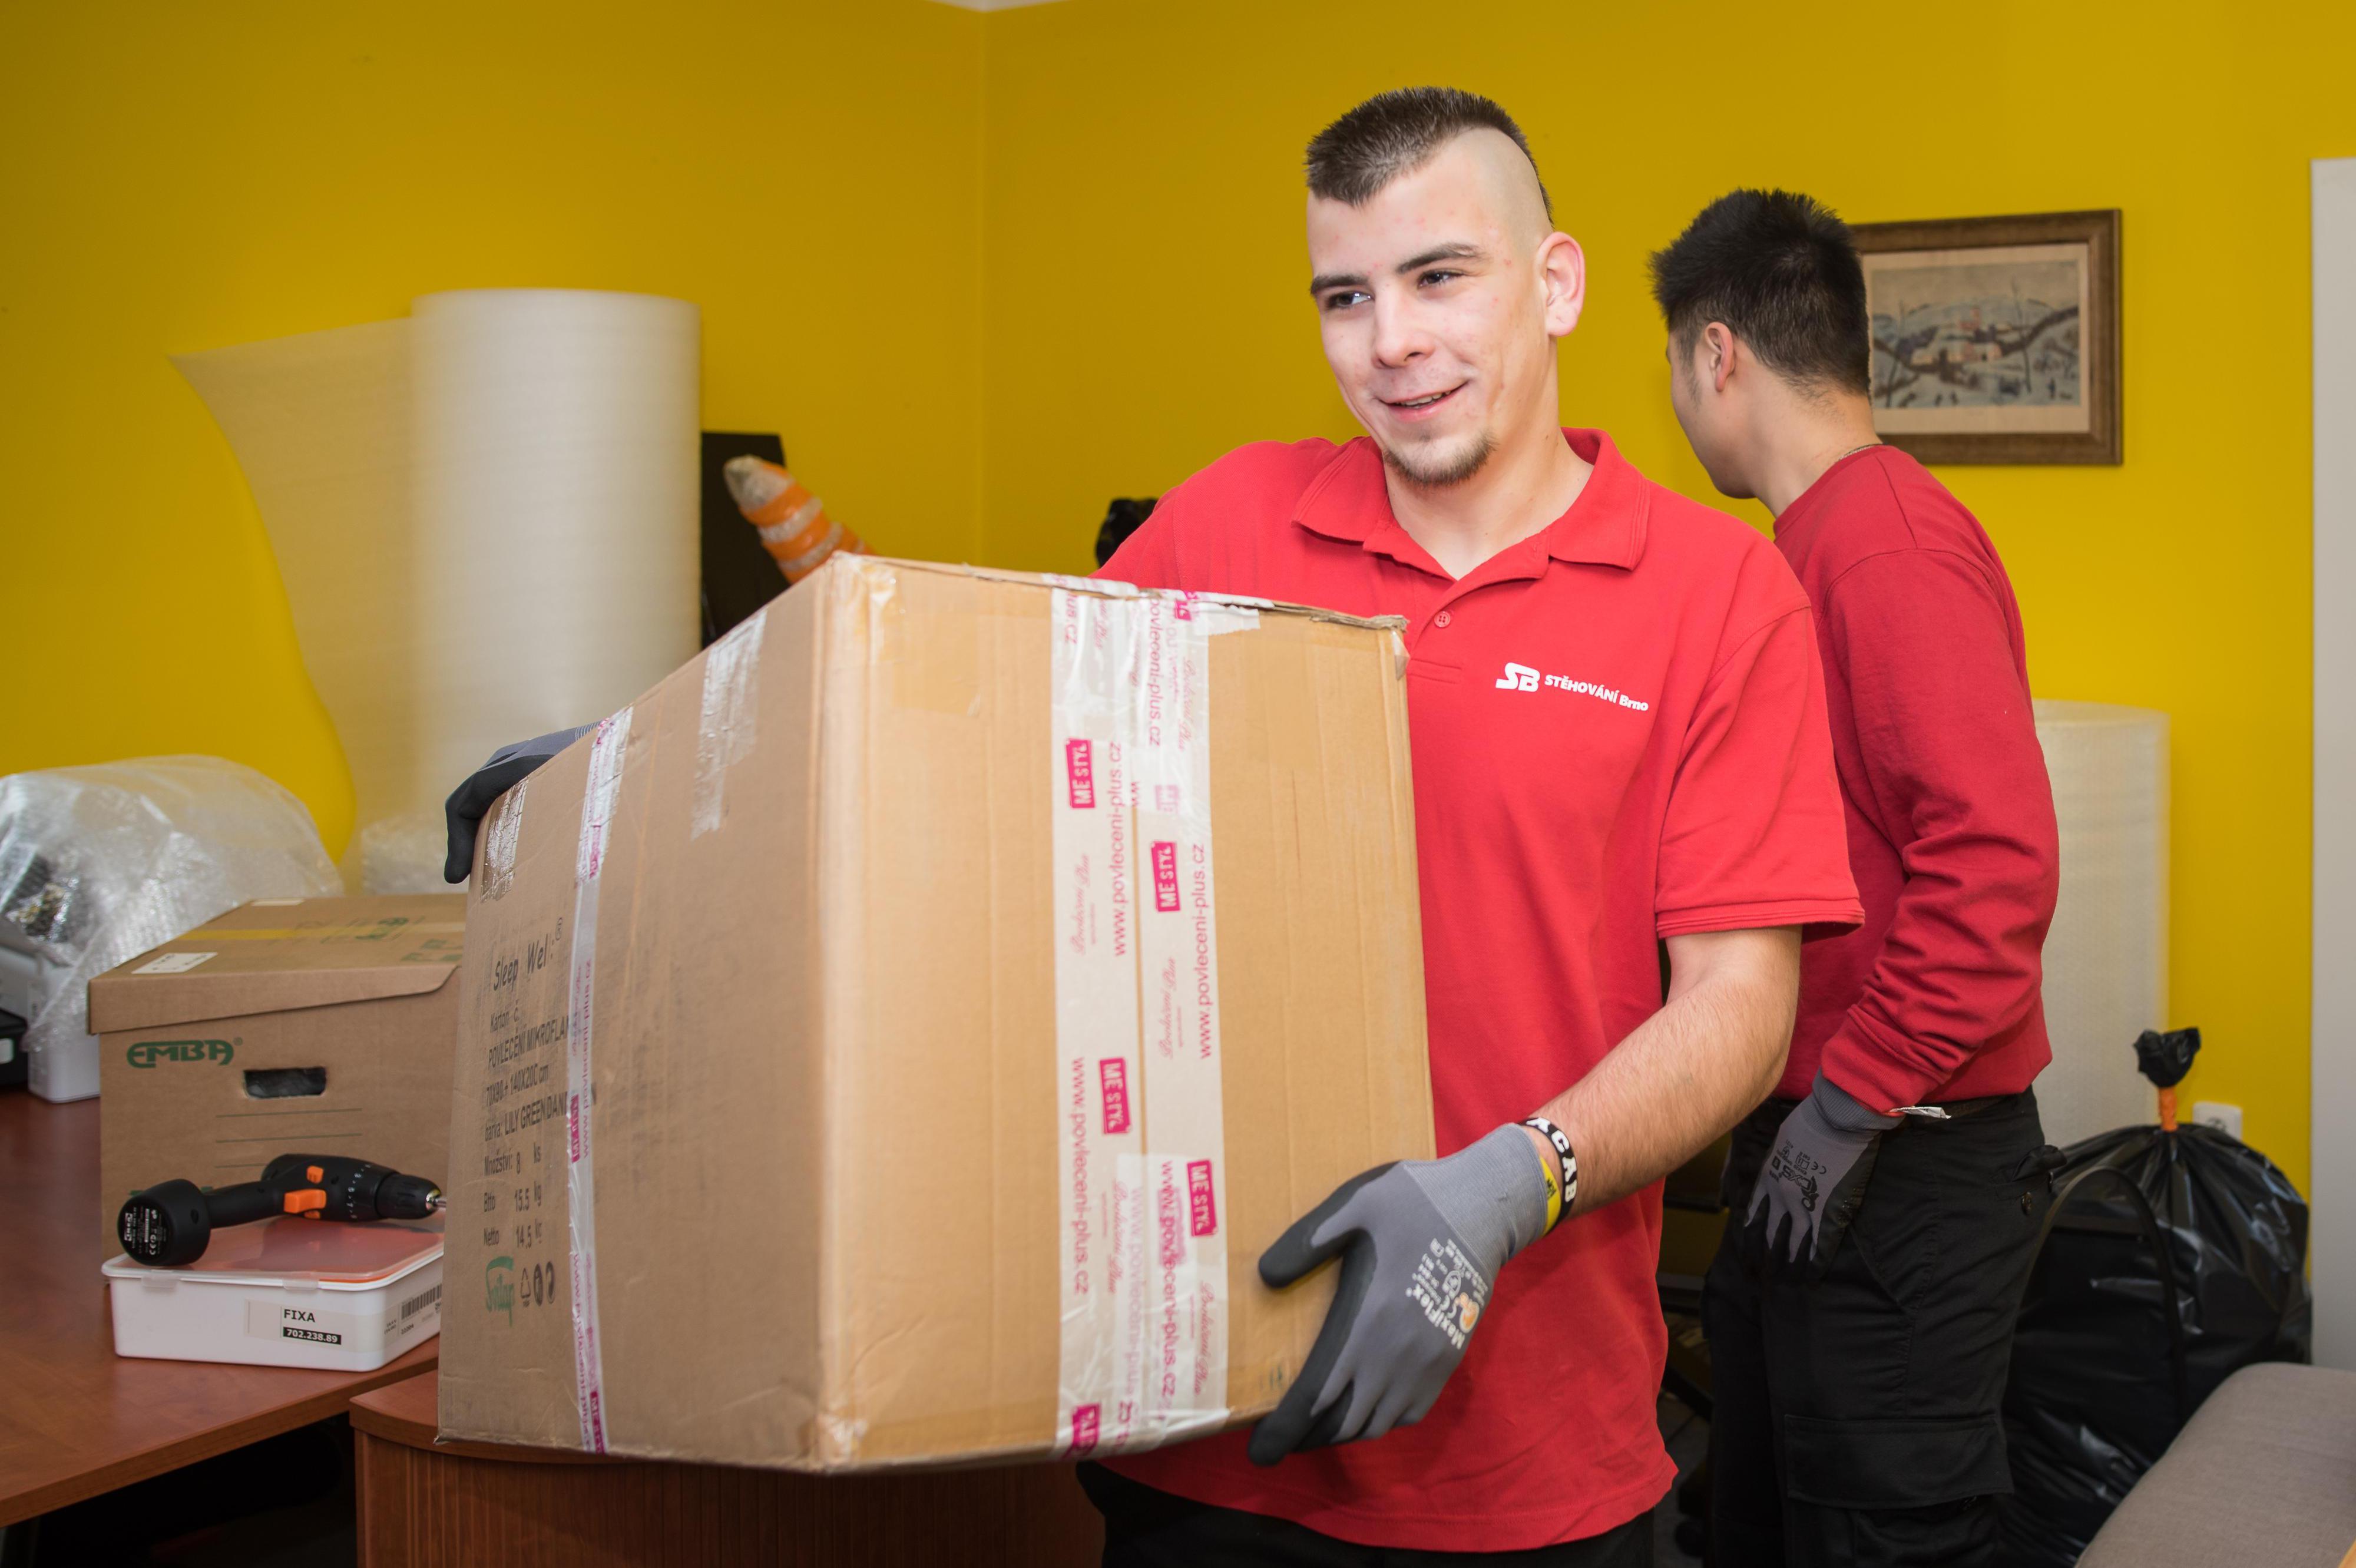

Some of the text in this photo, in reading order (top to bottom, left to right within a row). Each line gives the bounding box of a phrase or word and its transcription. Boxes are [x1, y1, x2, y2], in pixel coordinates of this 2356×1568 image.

[1495, 662, 1649, 712] SB STĚHOVÁNÍ Brno
[1071, 779, 1093, 805] ME
[1107, 741, 1129, 958] www.povleceni-plus.cz
[1159, 881, 1177, 908] ME
[1191, 842, 1213, 1060] www.povleceni-plus.cz
[493, 955, 519, 992] Sleep
[127, 1039, 234, 1069] EMBA
[488, 1023, 527, 1070] POVLEČENÍ
[540, 1063, 549, 1081] cm
[1103, 1061, 1123, 1090] ME
[504, 1109, 521, 1136] LILY
[521, 1098, 547, 1130] GREEN
[484, 1143, 541, 1177] Množství: 8 ks
[1069, 1057, 1091, 1294] www.povleceni-plus.cz
[1191, 1164, 1210, 1193] ME
[484, 1180, 542, 1213] Btto 15.5 kg
[484, 1227, 500, 1247] Netto
[1160, 1160, 1180, 1397] www.povleceni-plus.cz
[283, 1308, 316, 1324] FIXA
[286, 1329, 339, 1344] 702.238.89
